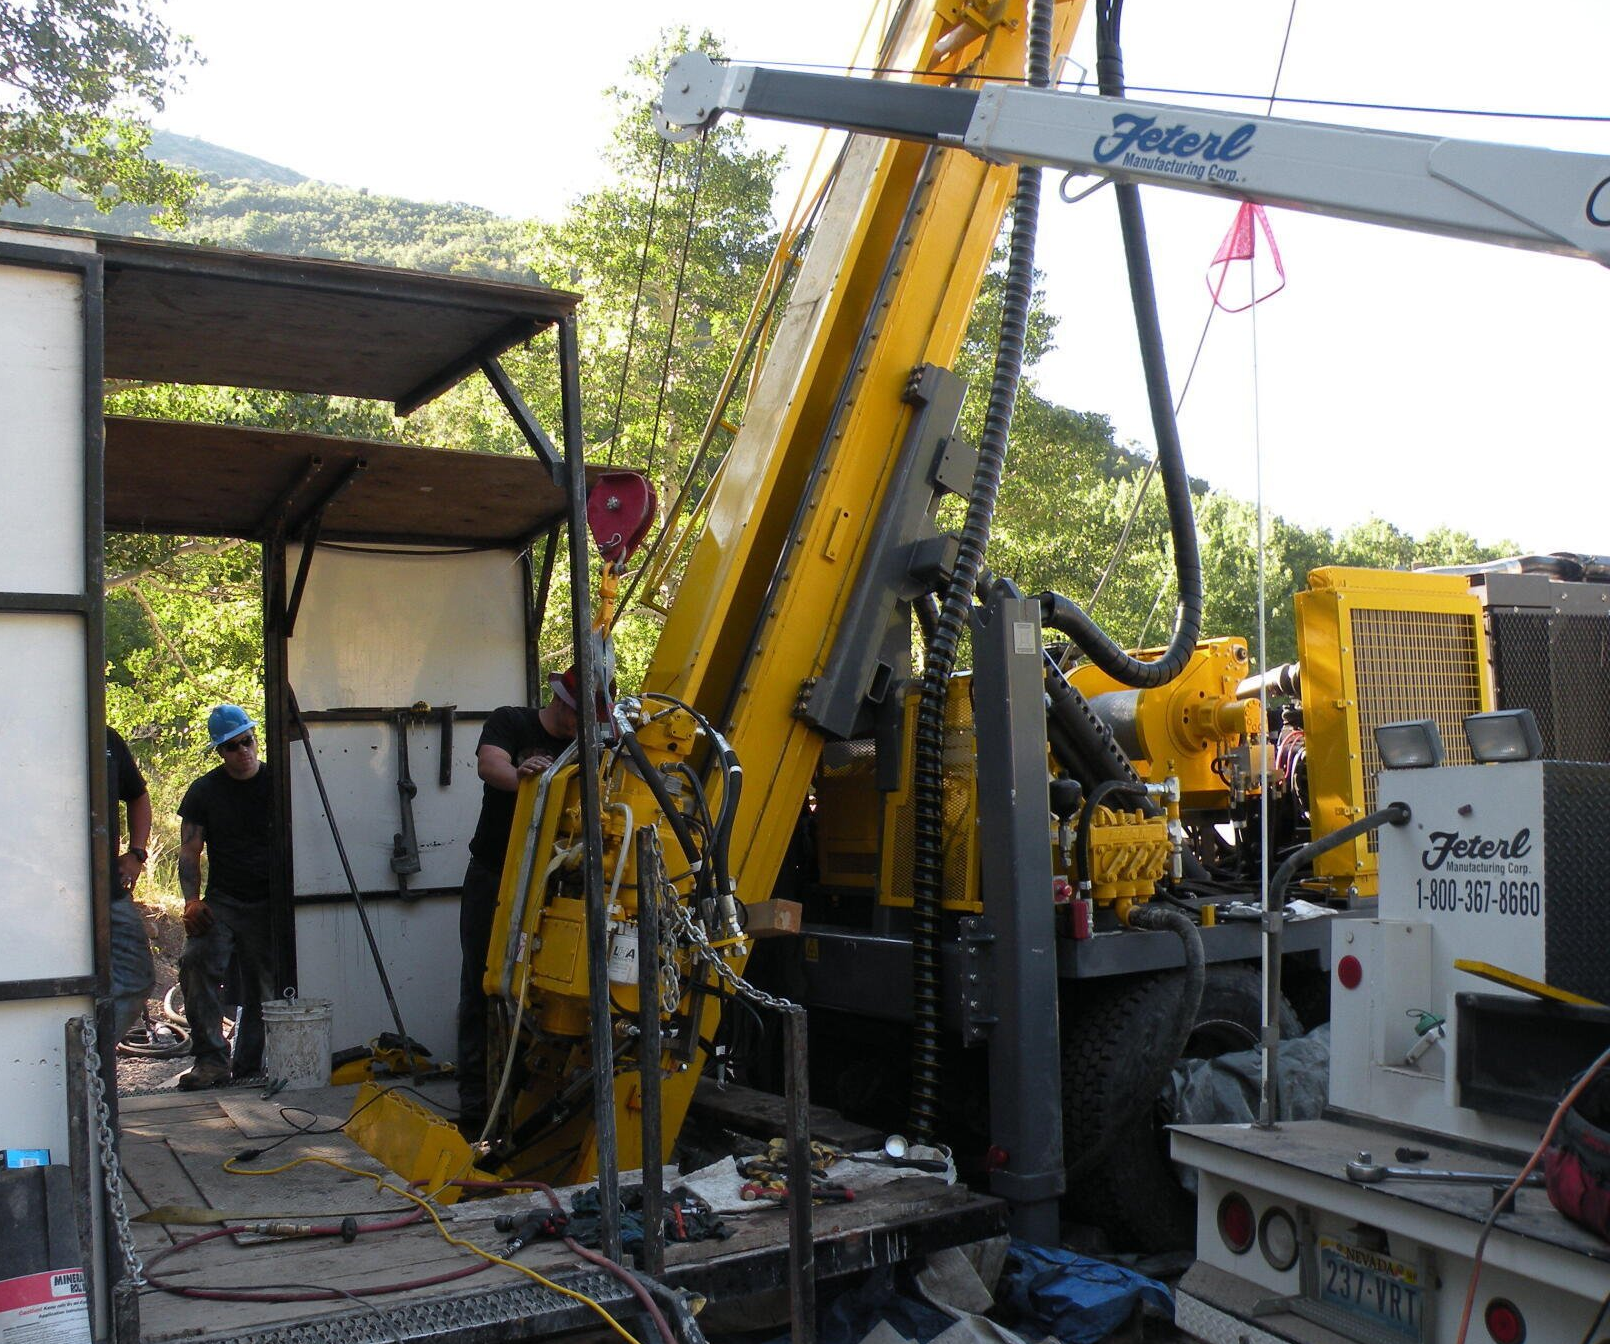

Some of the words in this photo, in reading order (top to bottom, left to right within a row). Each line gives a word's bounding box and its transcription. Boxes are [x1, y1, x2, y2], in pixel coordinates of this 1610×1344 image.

[1122, 152, 1206, 180] Manufacturing
[1208, 164, 1240, 183] Corp.
[1446, 861, 1505, 875] Manufacturing
[1508, 862, 1532, 876] Corp.
[1416, 878, 1540, 917] 1-800-367-8660
[1345, 1247, 1397, 1275] NEVADA
